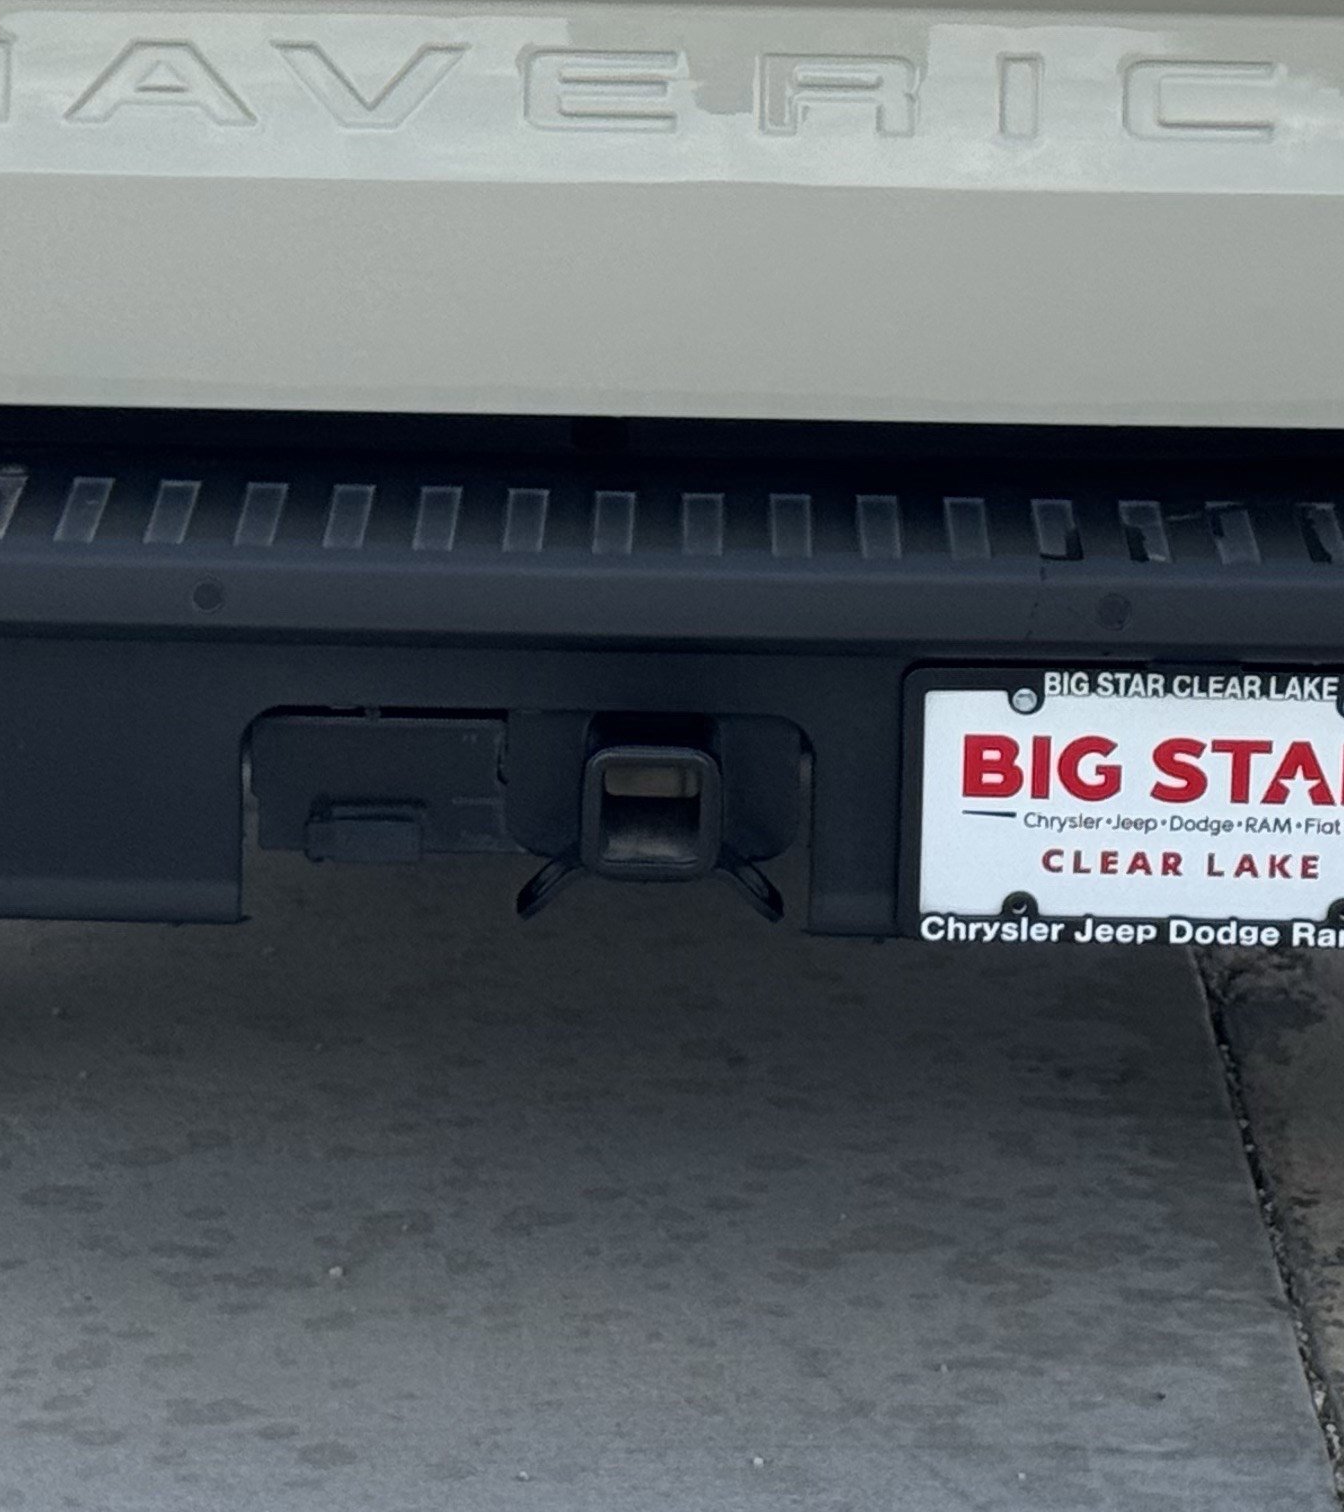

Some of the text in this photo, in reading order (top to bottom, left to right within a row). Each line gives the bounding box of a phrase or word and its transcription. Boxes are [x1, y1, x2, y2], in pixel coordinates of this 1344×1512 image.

[1044, 672, 1339, 700] BIG STAR CLEAR LAKE
[962, 734, 1122, 802] BIG
[1042, 848, 1320, 879] CLEAR LAKE
[920, 915, 1066, 945] Chrysler
[1074, 918, 1157, 946] Jeep
[1169, 920, 1280, 949] Dodge
